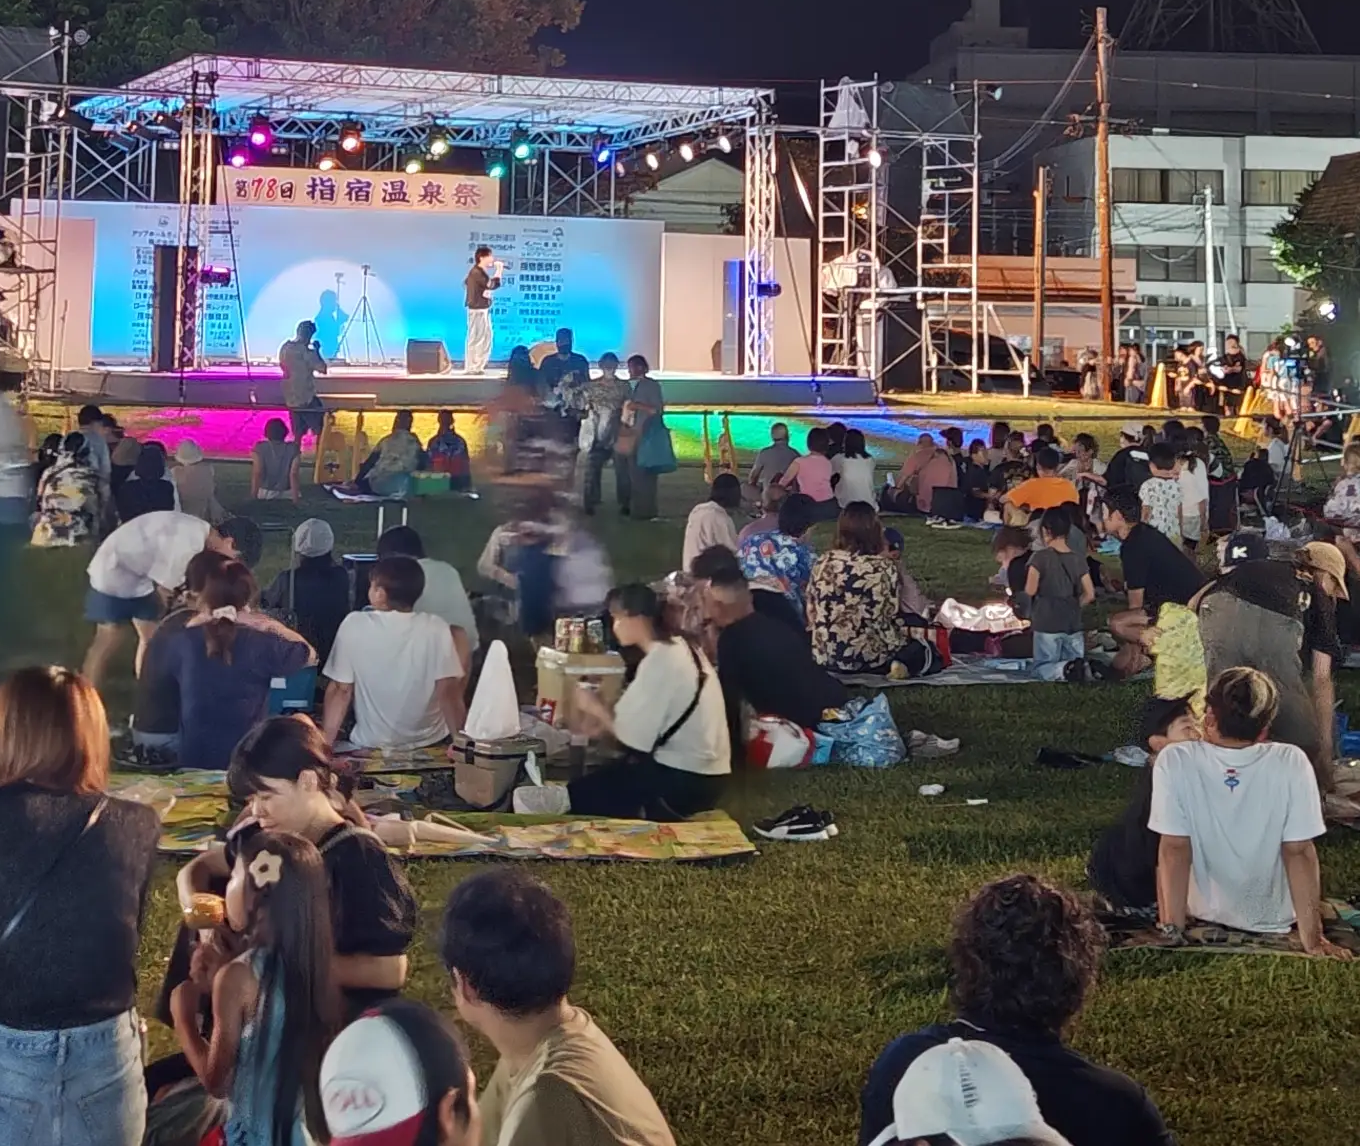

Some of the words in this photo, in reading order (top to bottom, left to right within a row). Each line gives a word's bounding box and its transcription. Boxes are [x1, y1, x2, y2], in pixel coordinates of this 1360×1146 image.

[304, 175, 484, 208] 指宿温泉祭
